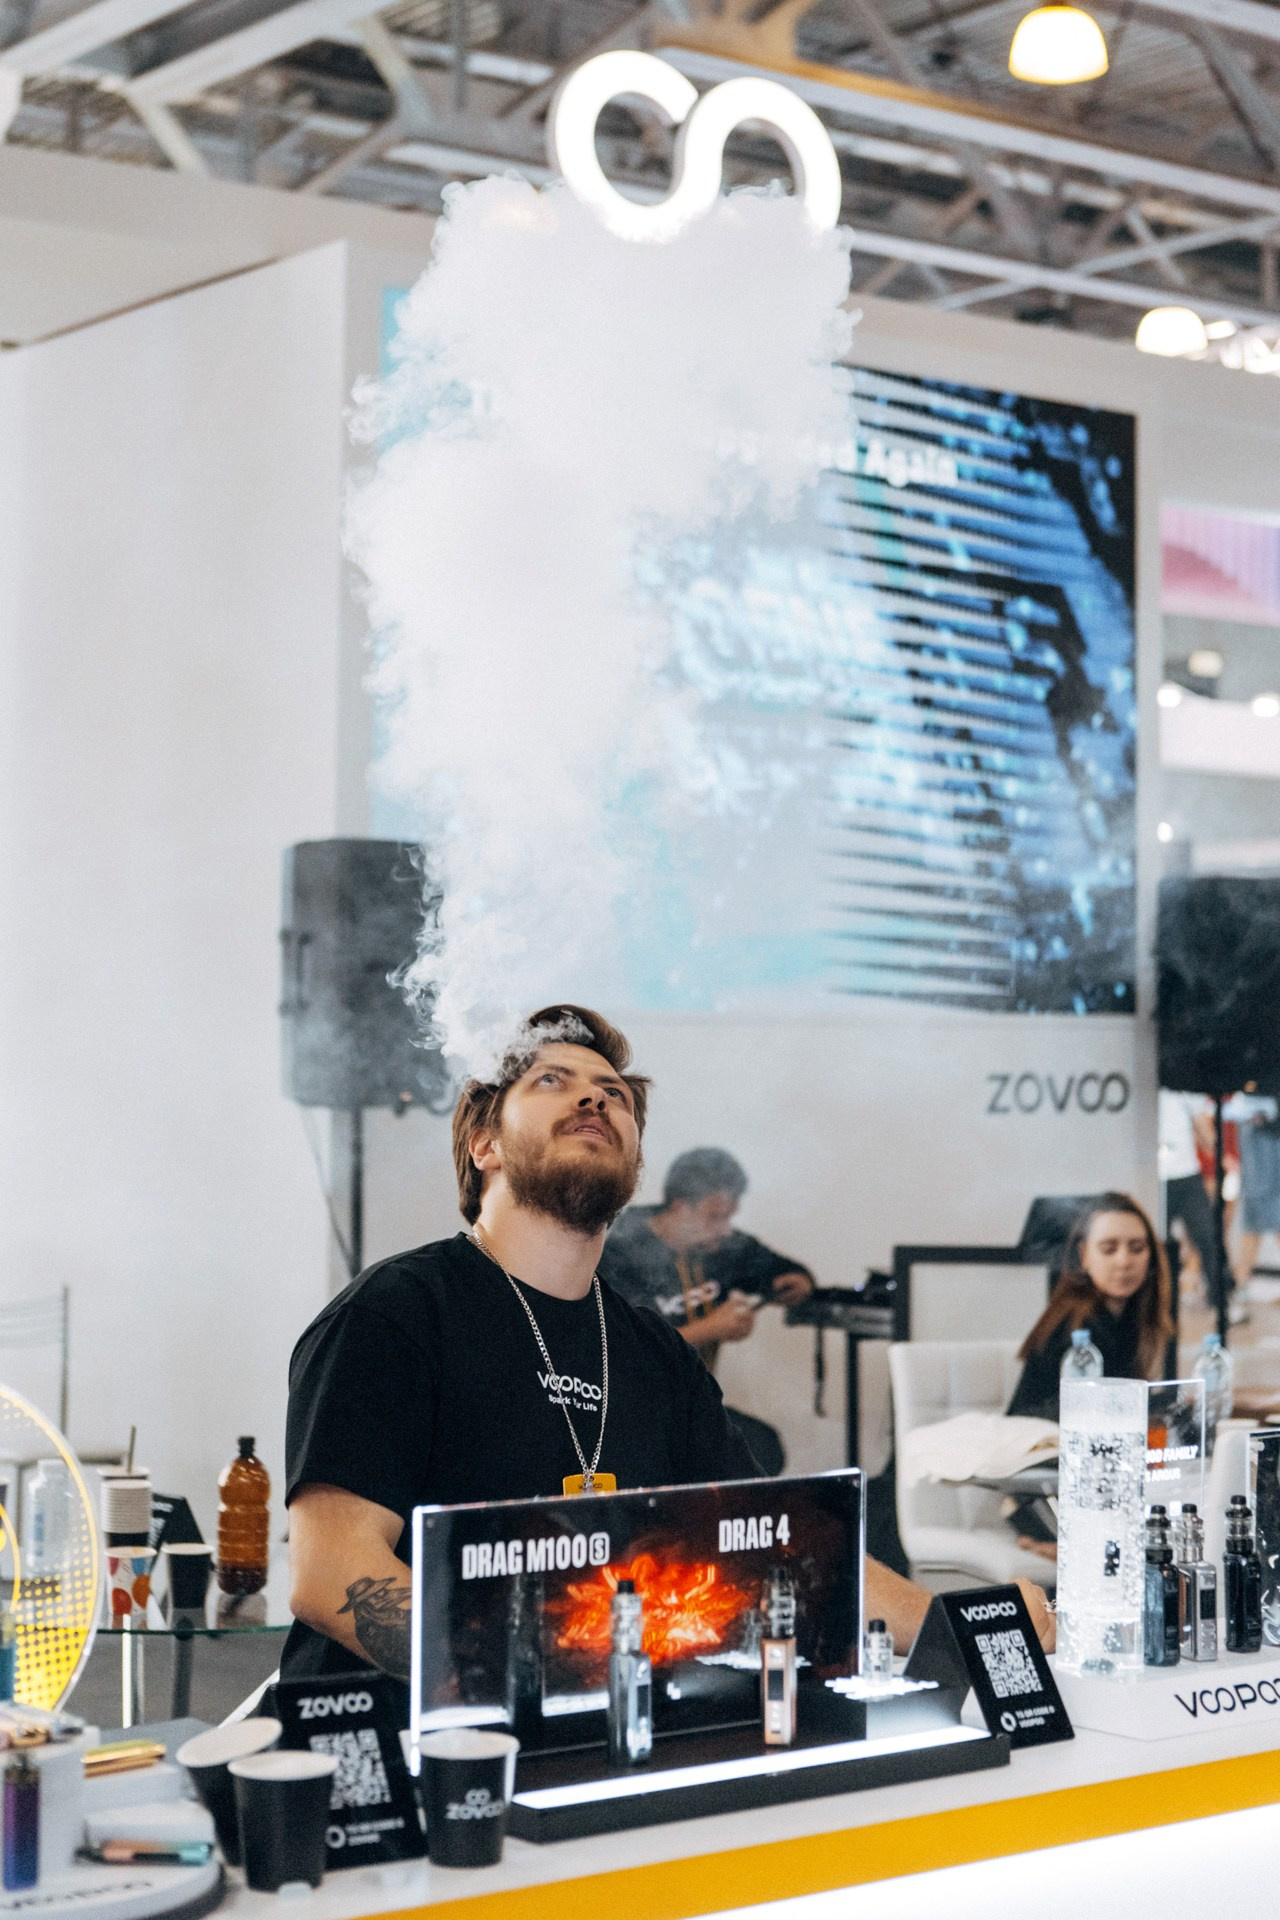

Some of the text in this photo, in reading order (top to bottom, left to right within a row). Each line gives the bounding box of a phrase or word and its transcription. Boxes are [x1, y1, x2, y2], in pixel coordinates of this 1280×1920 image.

[986, 1072, 1130, 1114] ZOVOO
[537, 1371, 602, 1400] VOOPOO
[583, 1402, 598, 1412] Life
[1163, 1445, 1198, 1462] FAMILY
[718, 1513, 791, 1553] DRAG 4
[462, 1540, 523, 1580] DRAG
[960, 1601, 1018, 1622] VOOPOO
[297, 1691, 373, 1719] ZOVOO
